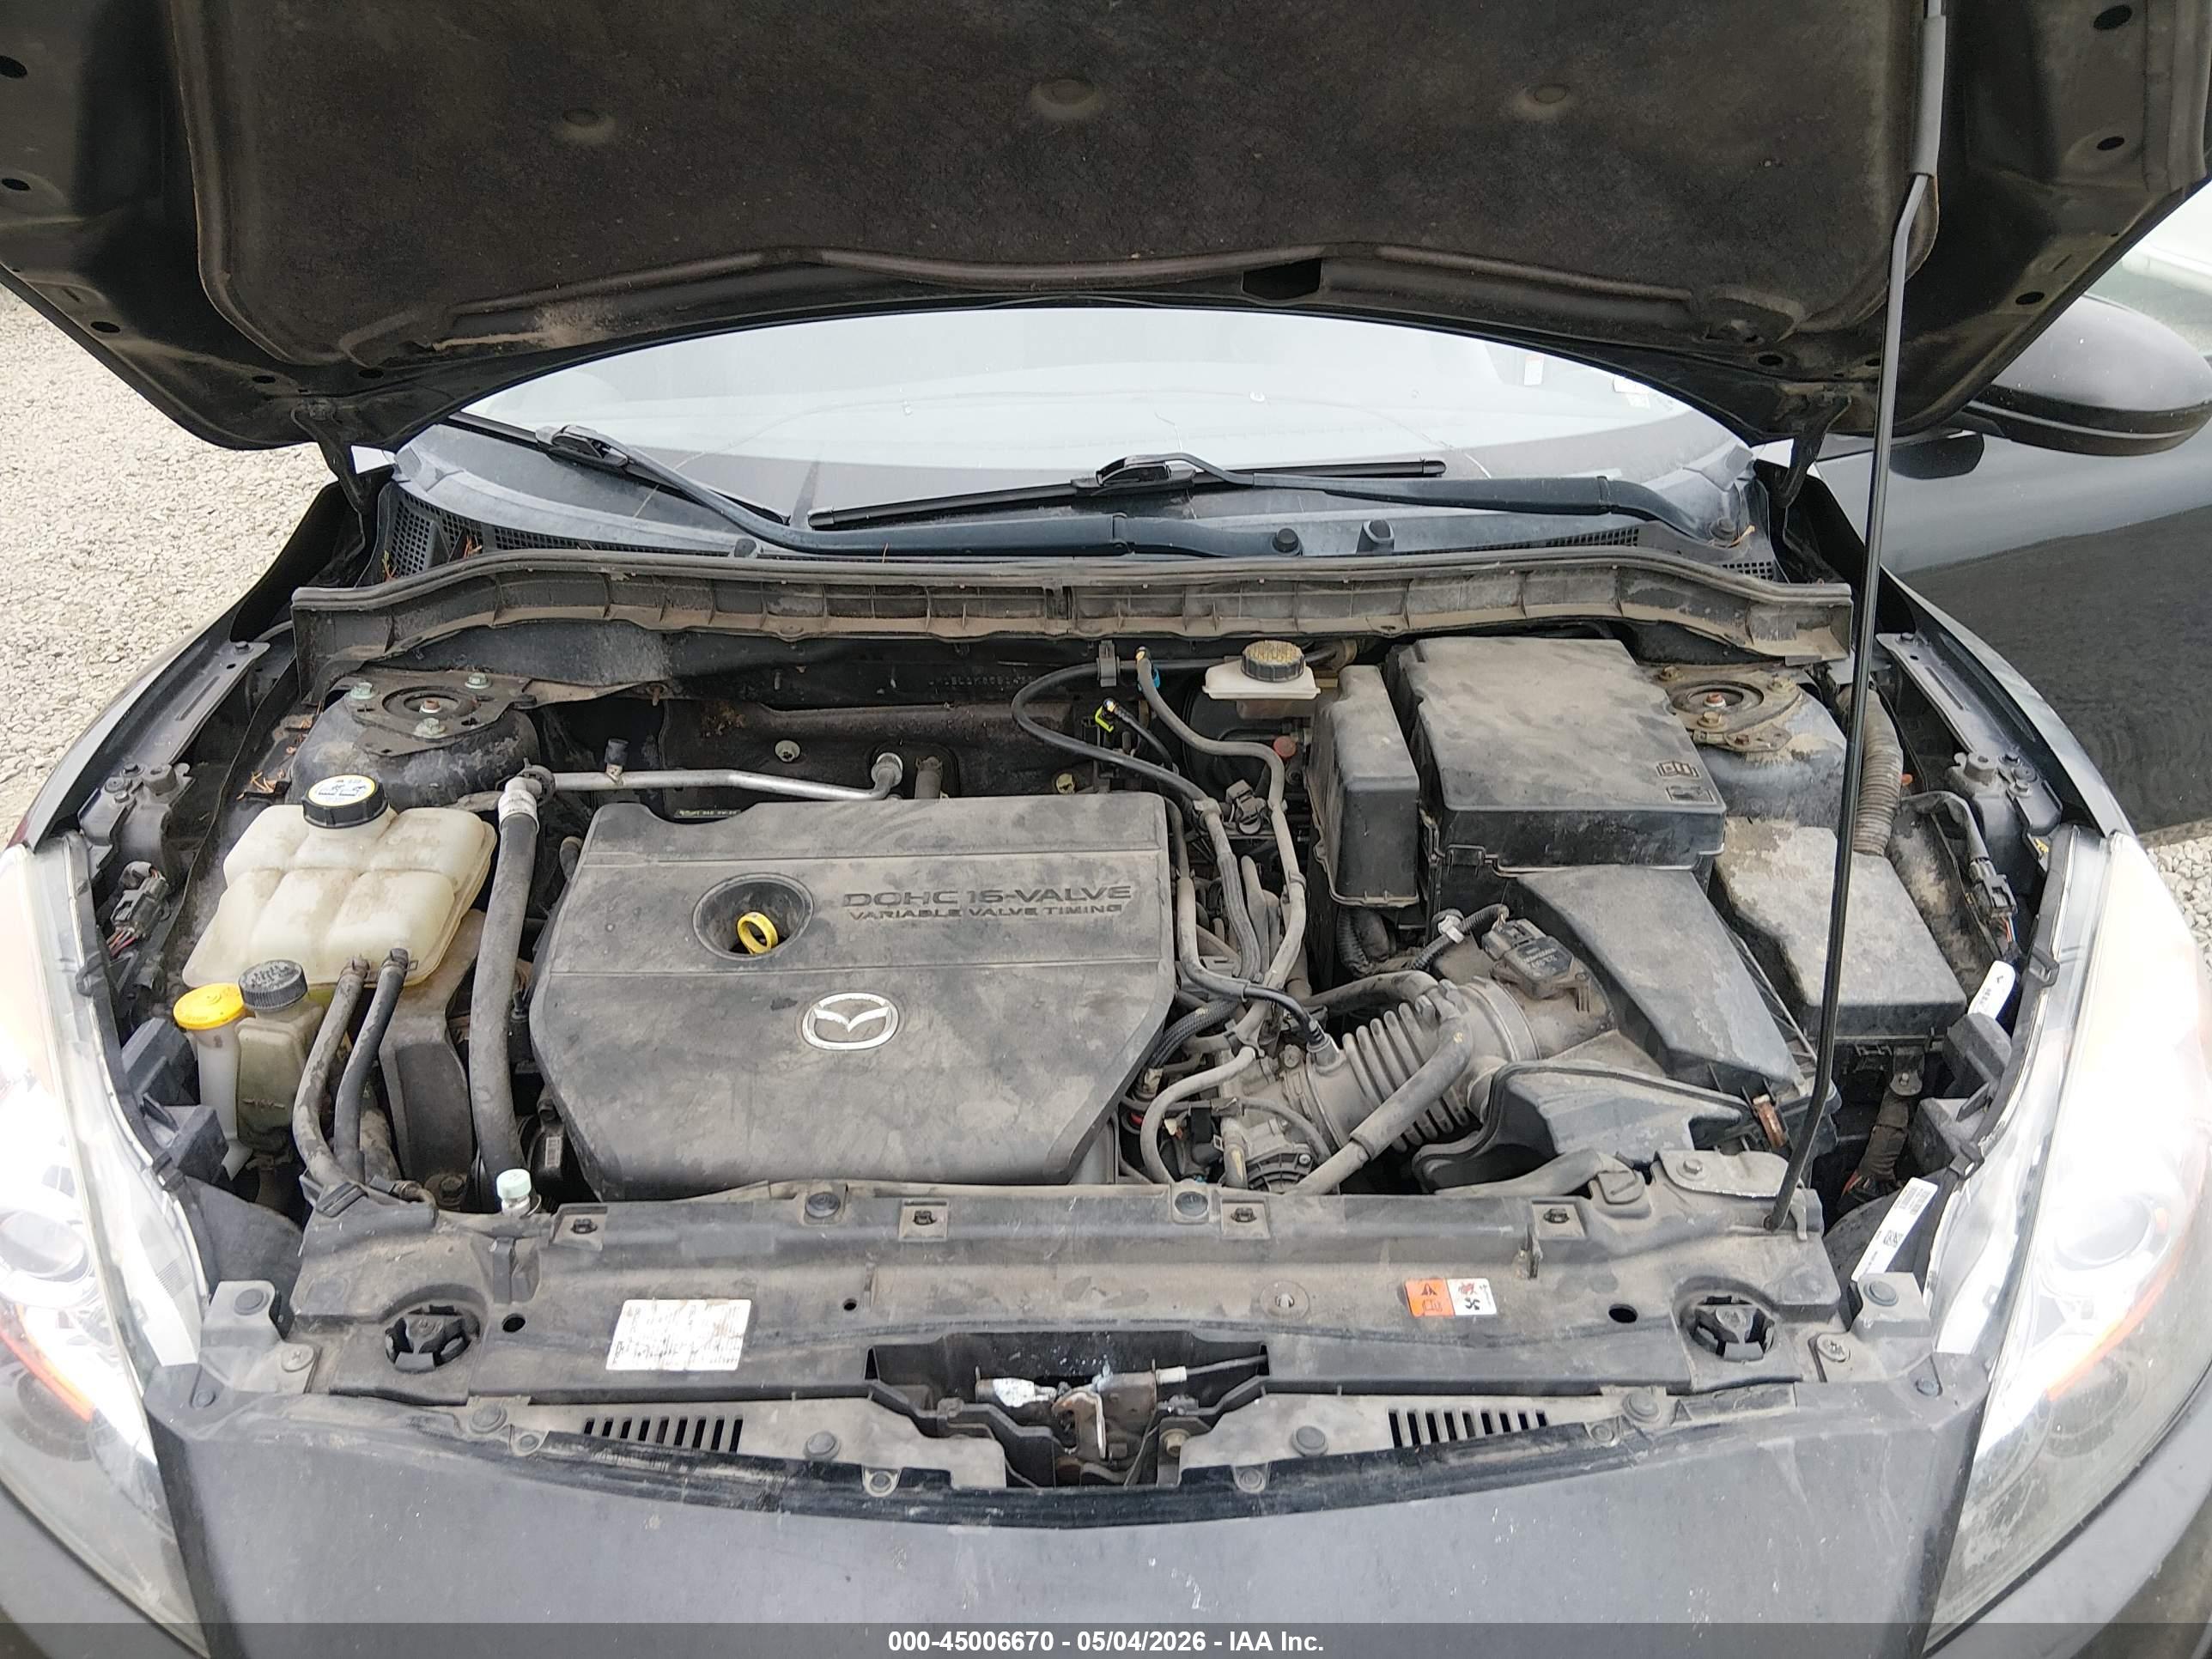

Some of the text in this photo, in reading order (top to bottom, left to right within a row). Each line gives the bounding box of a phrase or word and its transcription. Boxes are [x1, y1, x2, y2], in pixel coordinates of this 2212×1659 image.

[843, 885, 1131, 907] DOHC 16-VALVE
[849, 904, 1122, 921] VARIABLE VALVE TIMING
